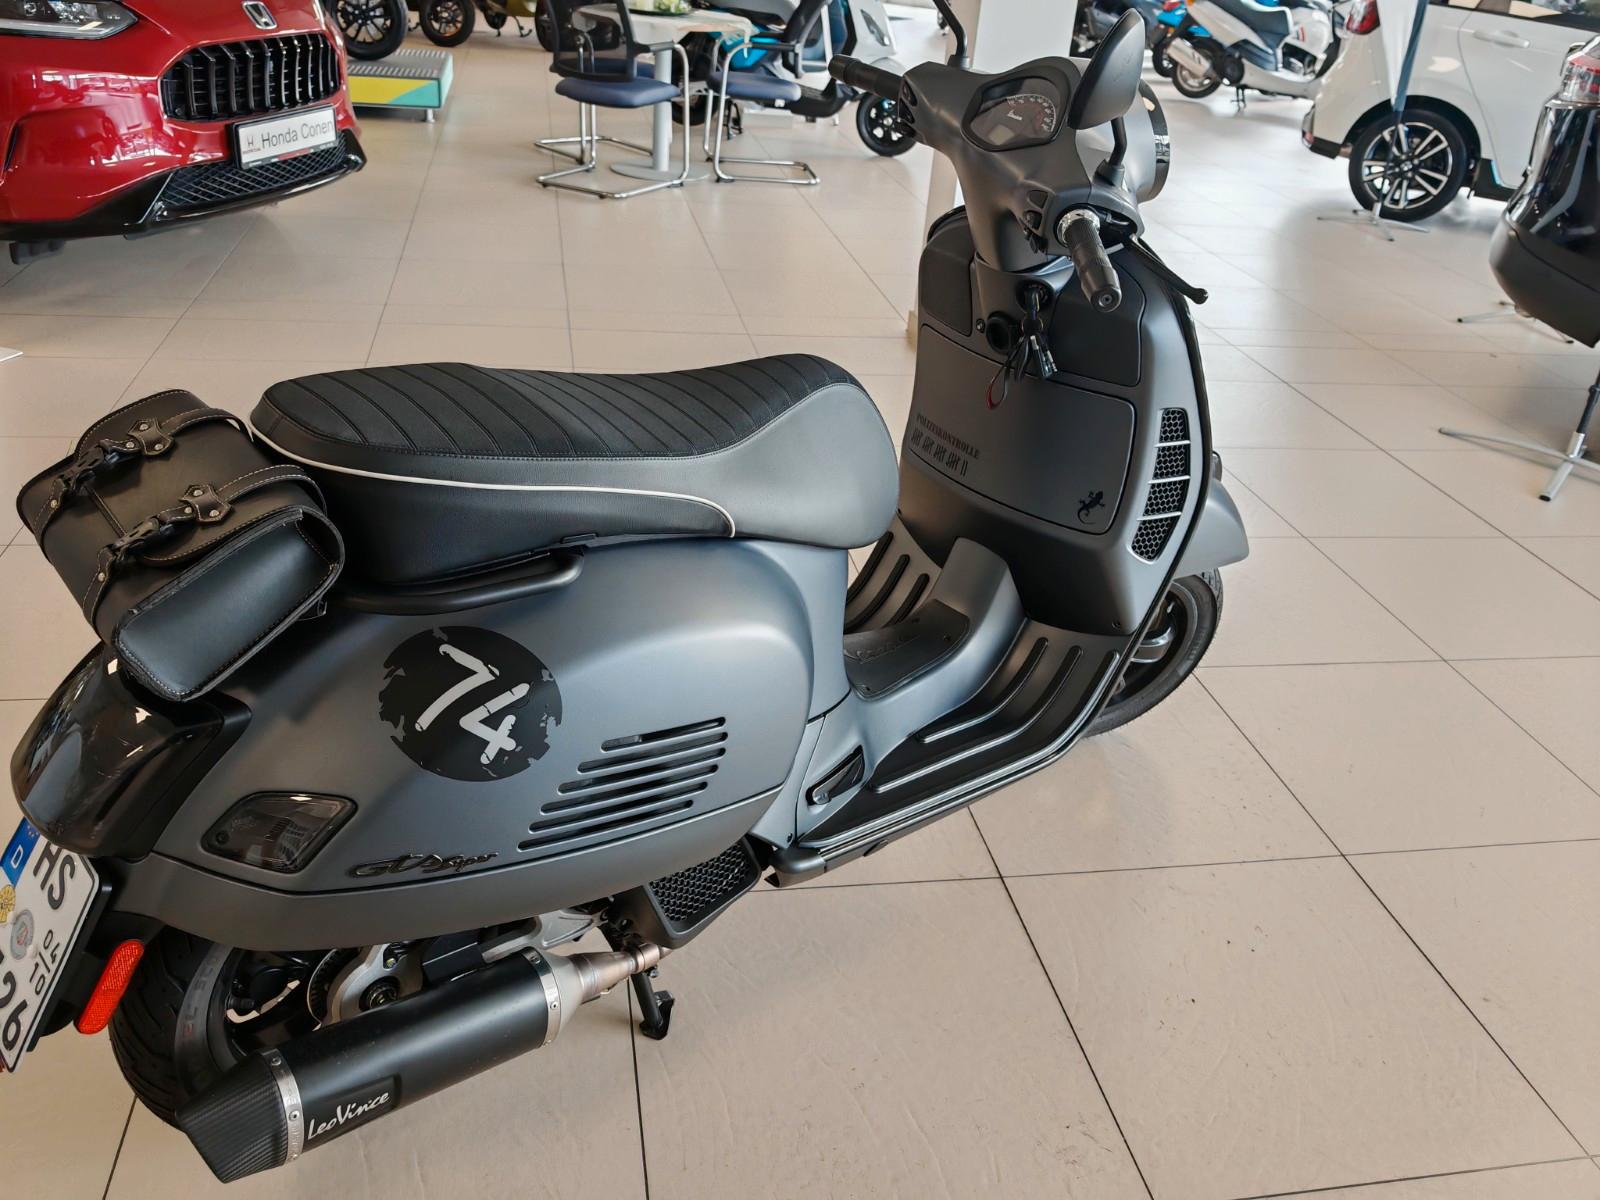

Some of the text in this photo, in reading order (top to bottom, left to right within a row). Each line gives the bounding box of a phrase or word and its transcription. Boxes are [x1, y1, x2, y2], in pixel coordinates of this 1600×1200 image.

[261, 128, 298, 149] Honda
[414, 643, 531, 765] 74
[10, 844, 24, 869] D
[33, 841, 76, 910] HS
[307, 1092, 390, 1140] LeoVince
